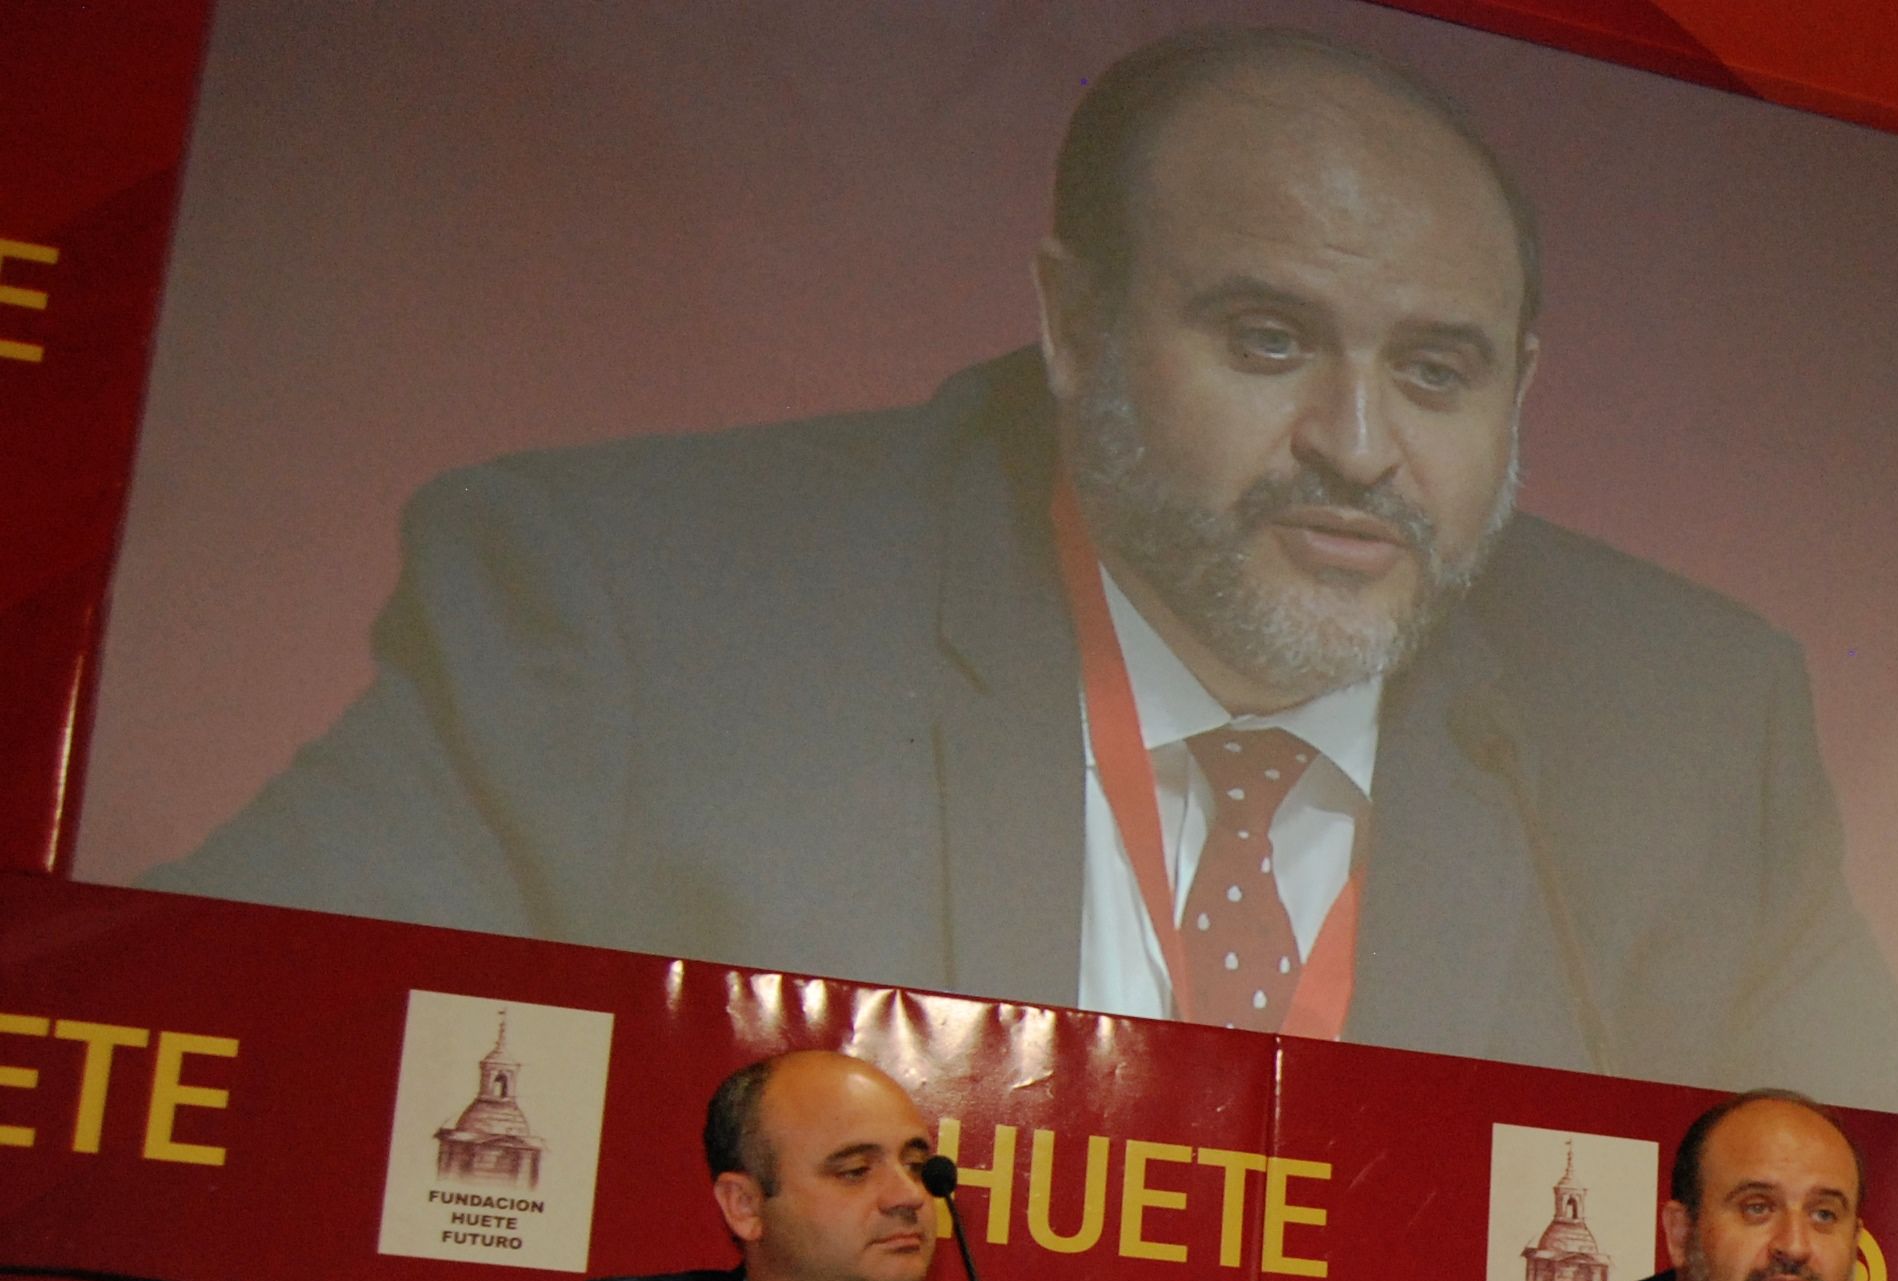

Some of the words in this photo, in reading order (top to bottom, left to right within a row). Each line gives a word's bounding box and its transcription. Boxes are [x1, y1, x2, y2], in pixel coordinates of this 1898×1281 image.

[428, 1190, 545, 1213] FUNDACION
[936, 1117, 1333, 1279] HUETE
[451, 1212, 518, 1230] HUETE
[441, 1230, 523, 1250] FUTURO
